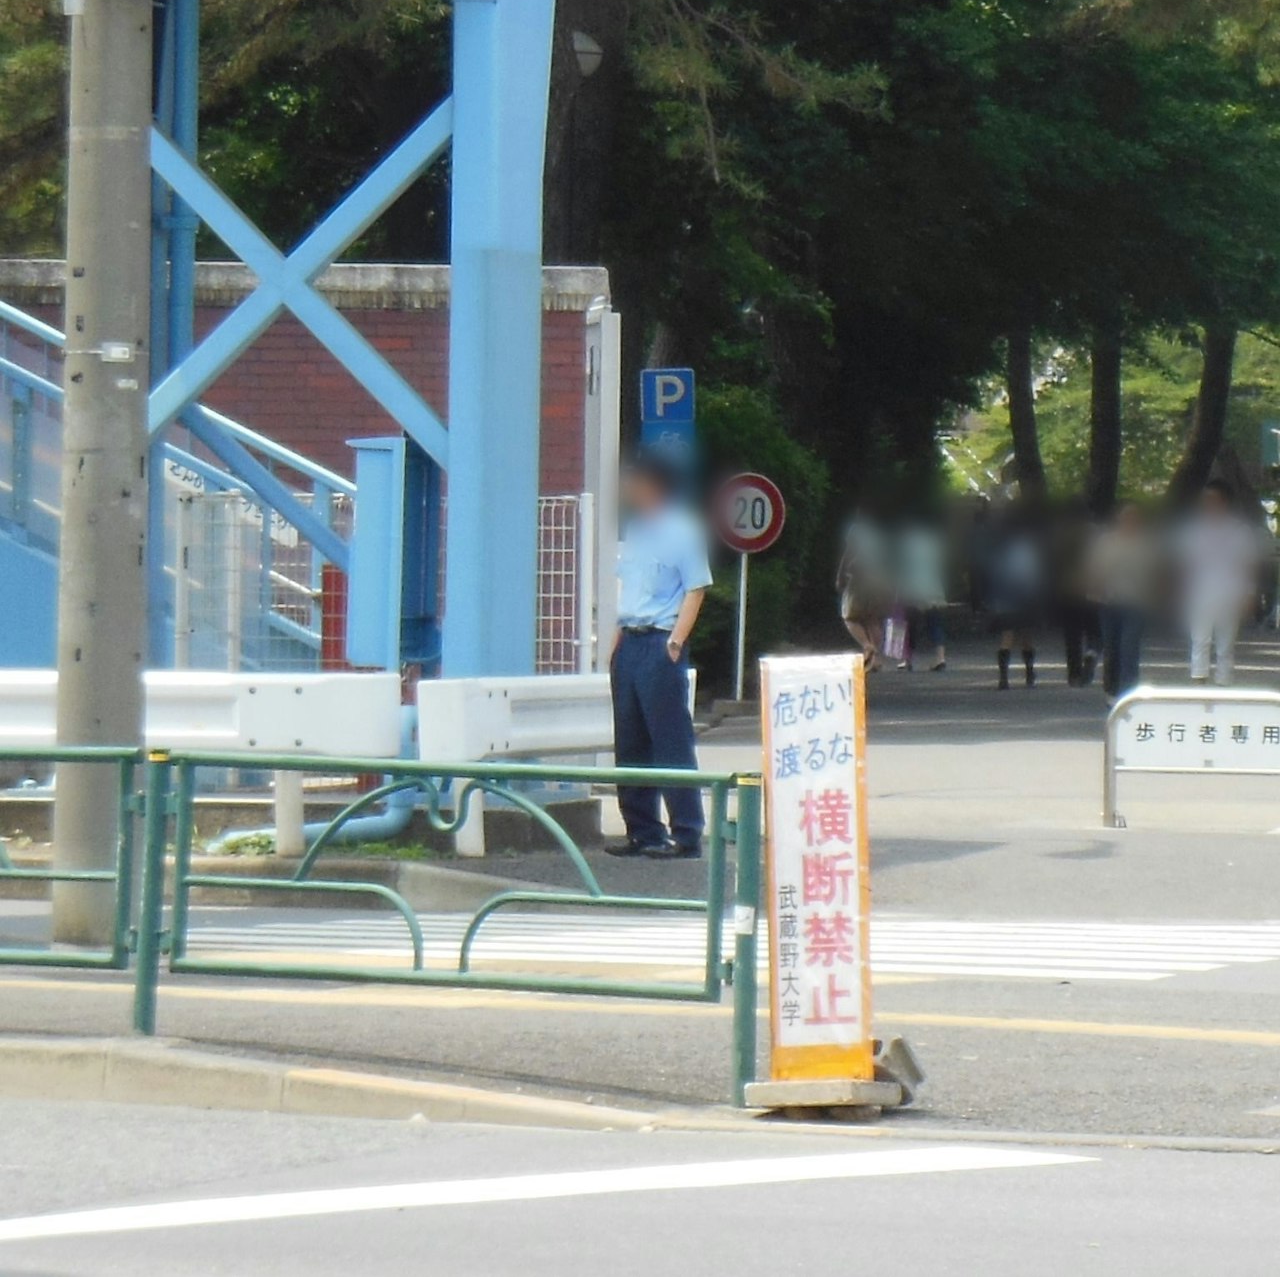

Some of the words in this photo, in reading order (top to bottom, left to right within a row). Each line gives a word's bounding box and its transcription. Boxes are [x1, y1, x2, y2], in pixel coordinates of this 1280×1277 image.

[655, 375, 685, 417] P
[734, 497, 766, 530] 20
[772, 678, 854, 728] 危ない!
[774, 731, 854, 780] 渡るな
[1135, 722, 1280, 745] 歩行者専用
[798, 788, 857, 1026] 横断禁止
[778, 884, 800, 1027] 武蔵野大学
